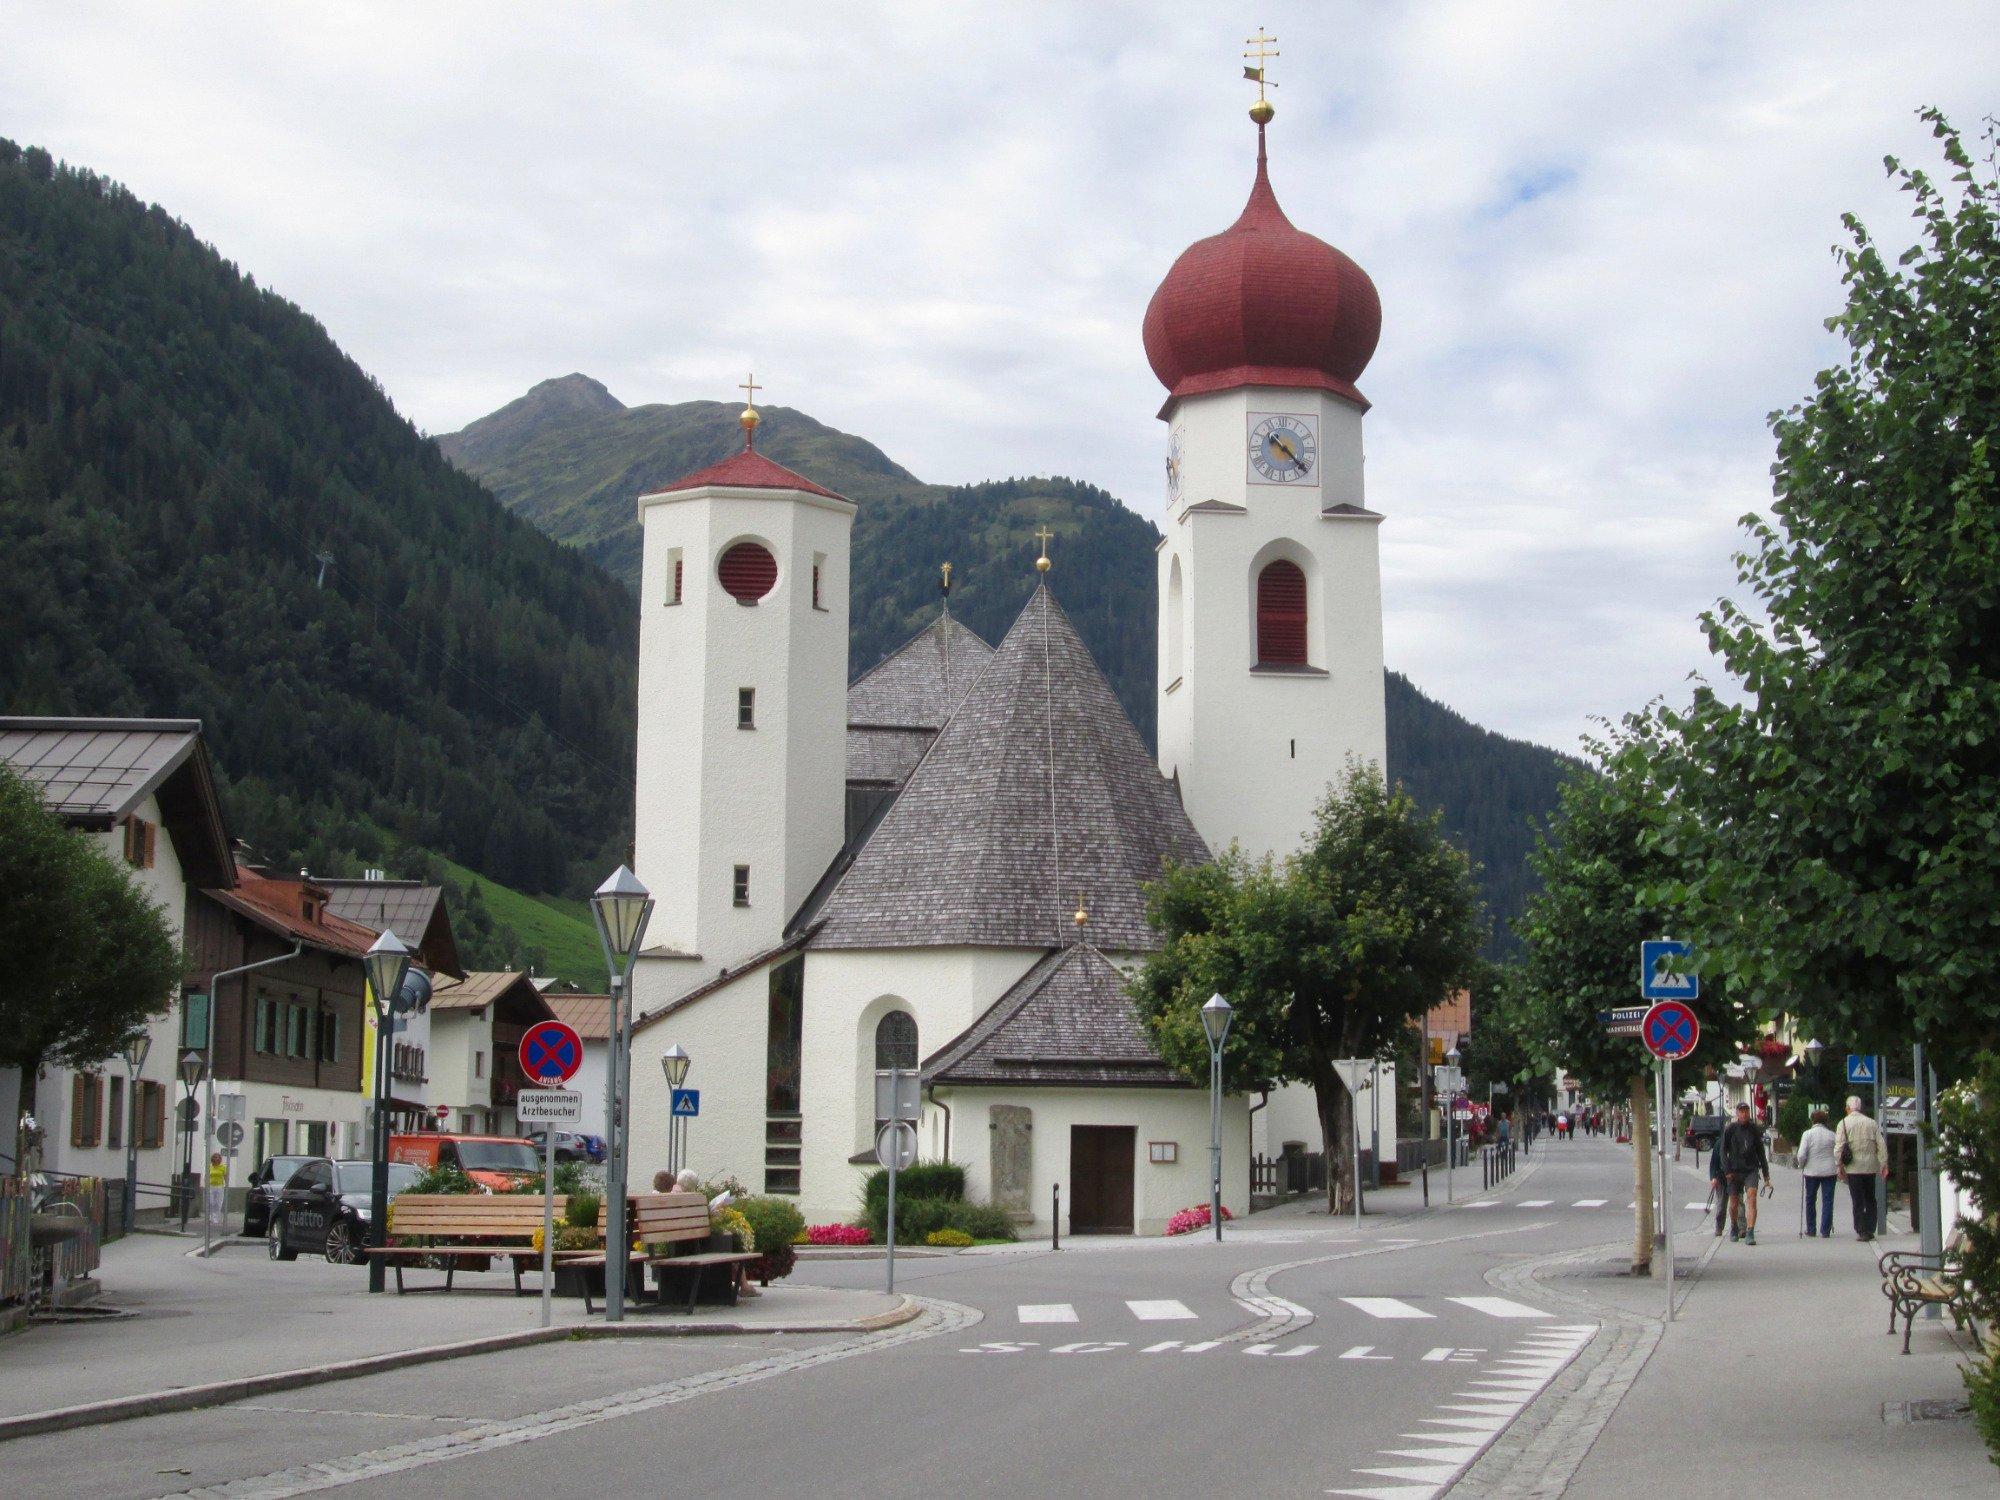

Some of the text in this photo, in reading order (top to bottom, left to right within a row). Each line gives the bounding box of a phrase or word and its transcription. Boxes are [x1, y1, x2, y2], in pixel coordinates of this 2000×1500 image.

[1612, 1011, 1640, 1020] POLIZEI
[1606, 1025, 1643, 1033] MARKTSTRASS
[538, 1075, 563, 1085] ANFANG
[520, 1094, 578, 1105] ausgenommen
[522, 1106, 576, 1116] Arztbesucher
[288, 1210, 324, 1229] quattro
[958, 1340, 1488, 1362] SCHULE
